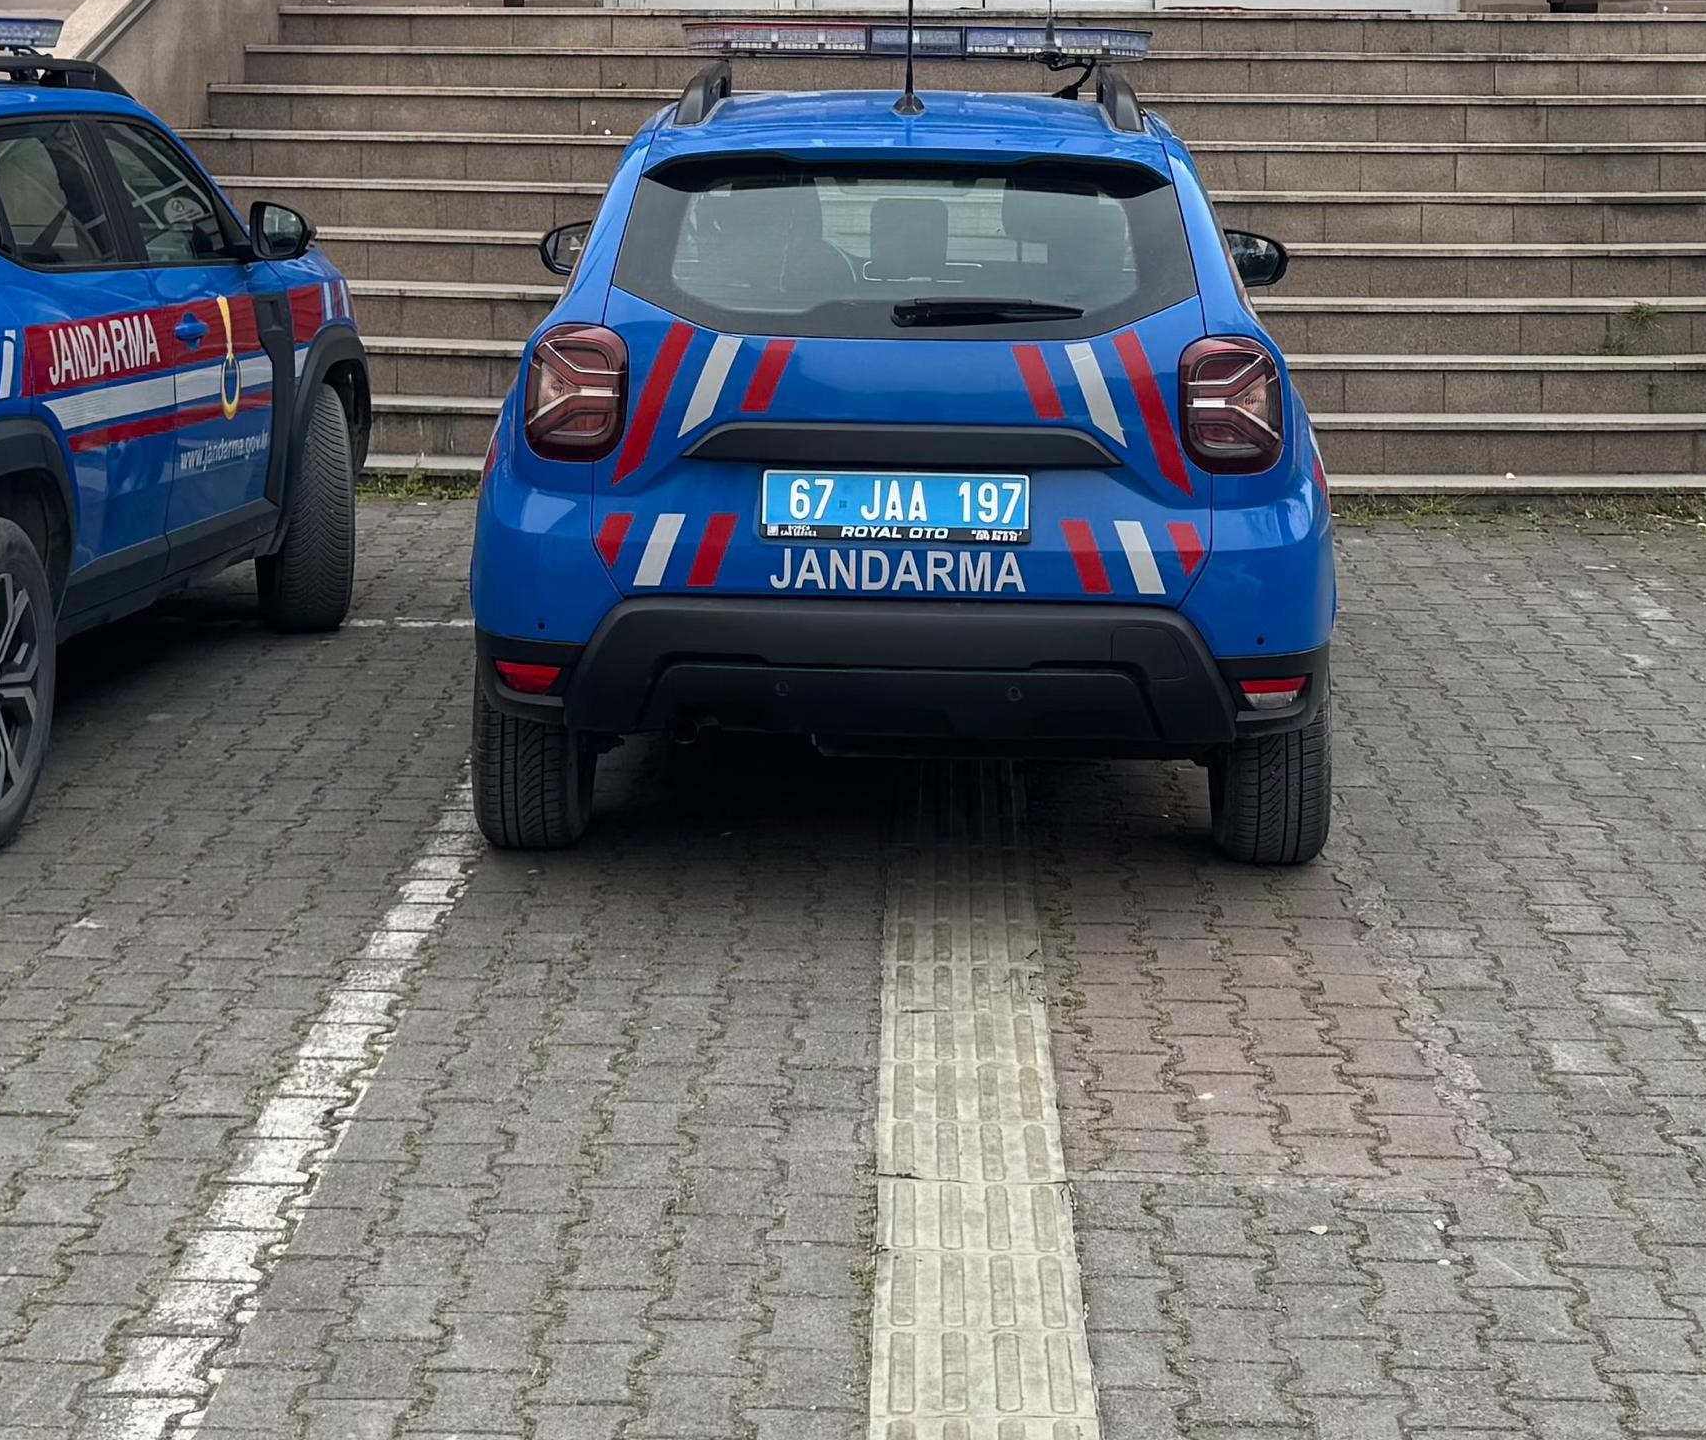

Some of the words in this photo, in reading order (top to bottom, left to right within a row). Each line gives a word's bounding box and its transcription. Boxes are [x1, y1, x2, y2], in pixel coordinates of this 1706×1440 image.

[48, 313, 161, 386] JANDARMA
[789, 478, 834, 520] 67
[860, 480, 928, 522] JAA
[957, 481, 1022, 524] 197
[841, 526, 902, 538] ROYAL
[908, 527, 949, 539] OTO
[769, 548, 1026, 593] JANDARMA
